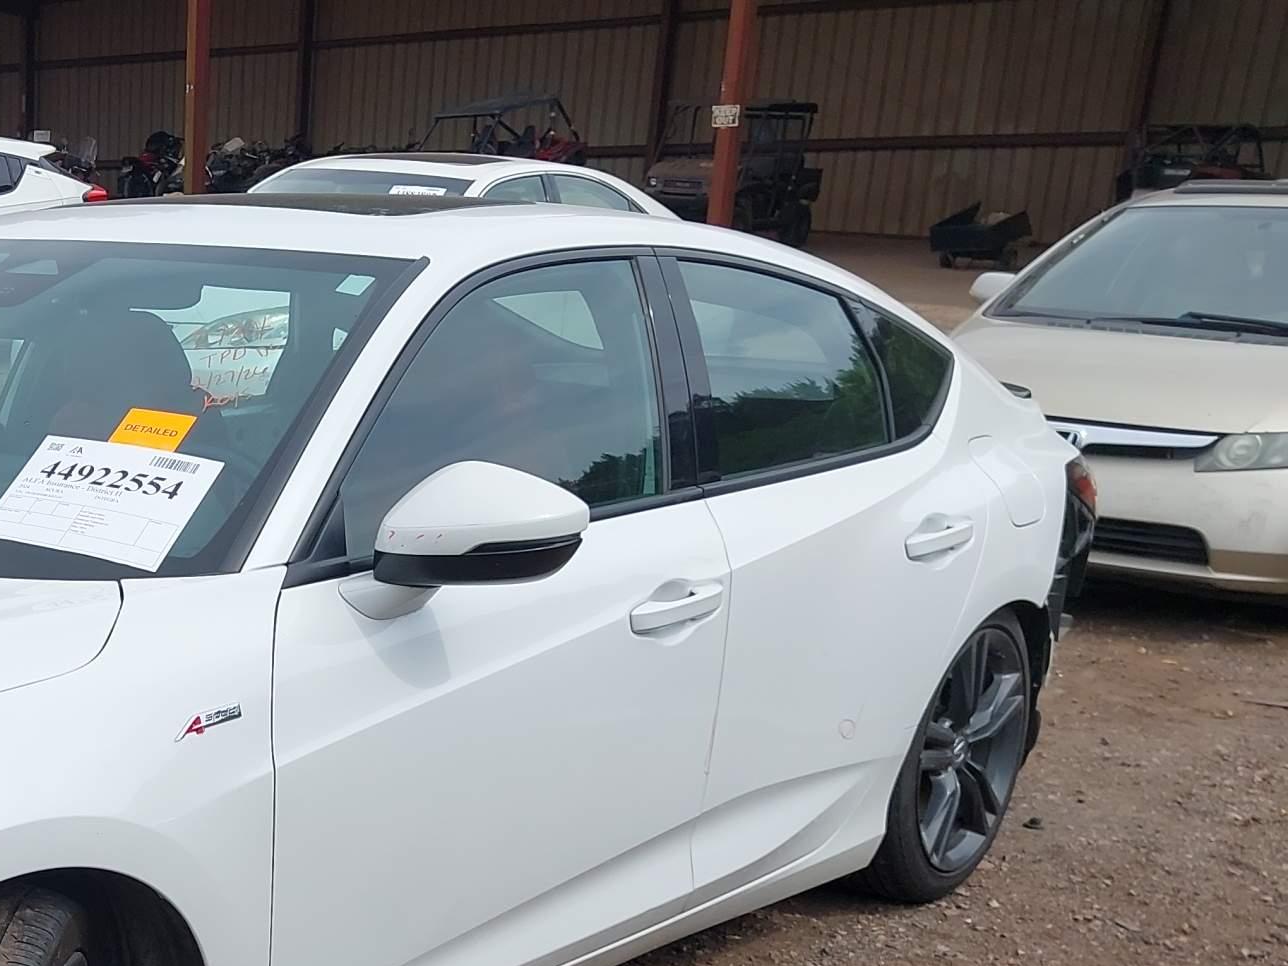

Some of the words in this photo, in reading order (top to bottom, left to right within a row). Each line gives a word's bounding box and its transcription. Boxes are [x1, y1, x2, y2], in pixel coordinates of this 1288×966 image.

[123, 423, 179, 439] DETAILED
[40, 459, 184, 500] 44922554
[46, 480, 81, 490] Insurance
